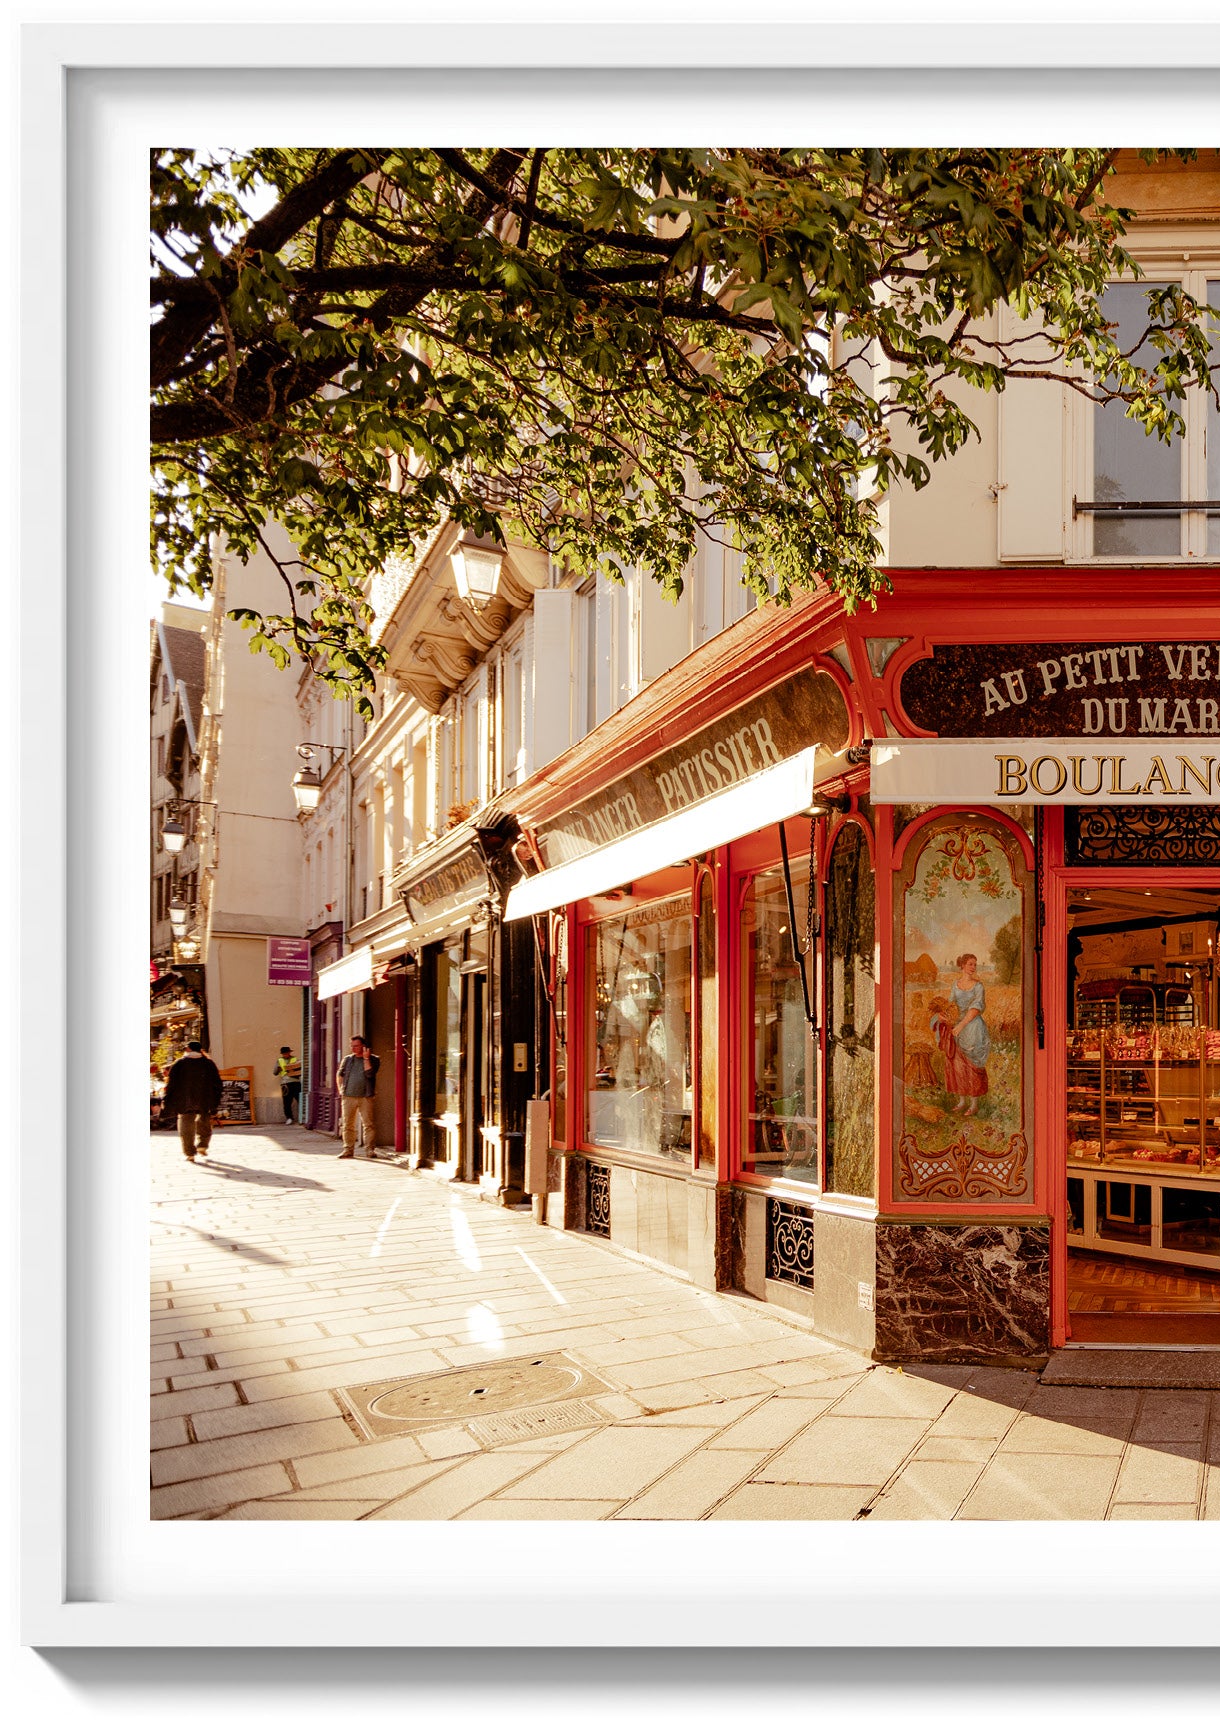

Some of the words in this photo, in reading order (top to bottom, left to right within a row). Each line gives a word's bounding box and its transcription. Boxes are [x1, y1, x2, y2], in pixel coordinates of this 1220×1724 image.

[980, 669, 1028, 717] AU
[1037, 645, 1144, 696] PETIT
[1080, 698, 1130, 734] DU
[655, 717, 783, 815] PATISSIER
